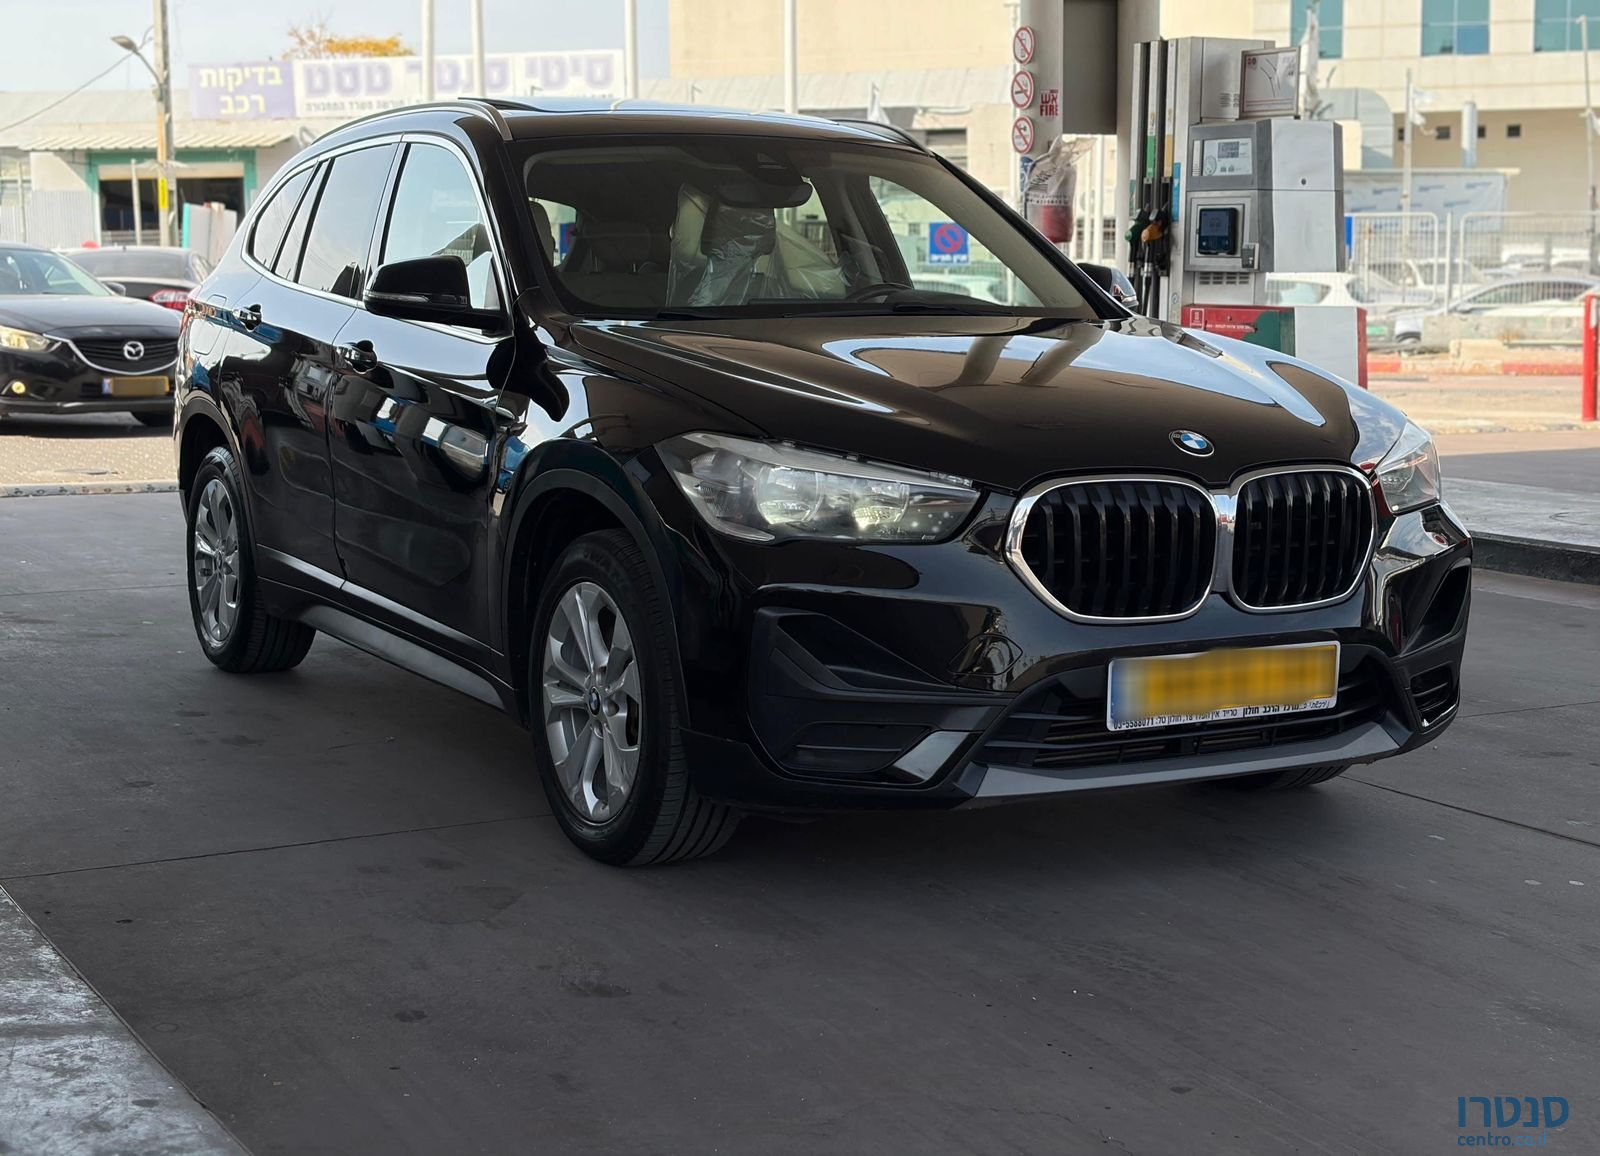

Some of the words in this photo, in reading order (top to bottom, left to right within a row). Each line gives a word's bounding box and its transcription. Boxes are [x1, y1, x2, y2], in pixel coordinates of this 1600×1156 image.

[199, 65, 284, 91] בדיקות
[303, 61, 393, 97] טסט
[220, 94, 267, 115] רכב
[1041, 93, 1058, 104] אש
[1040, 104, 1059, 116] FIRE
[1243, 706, 1260, 717] חולון
